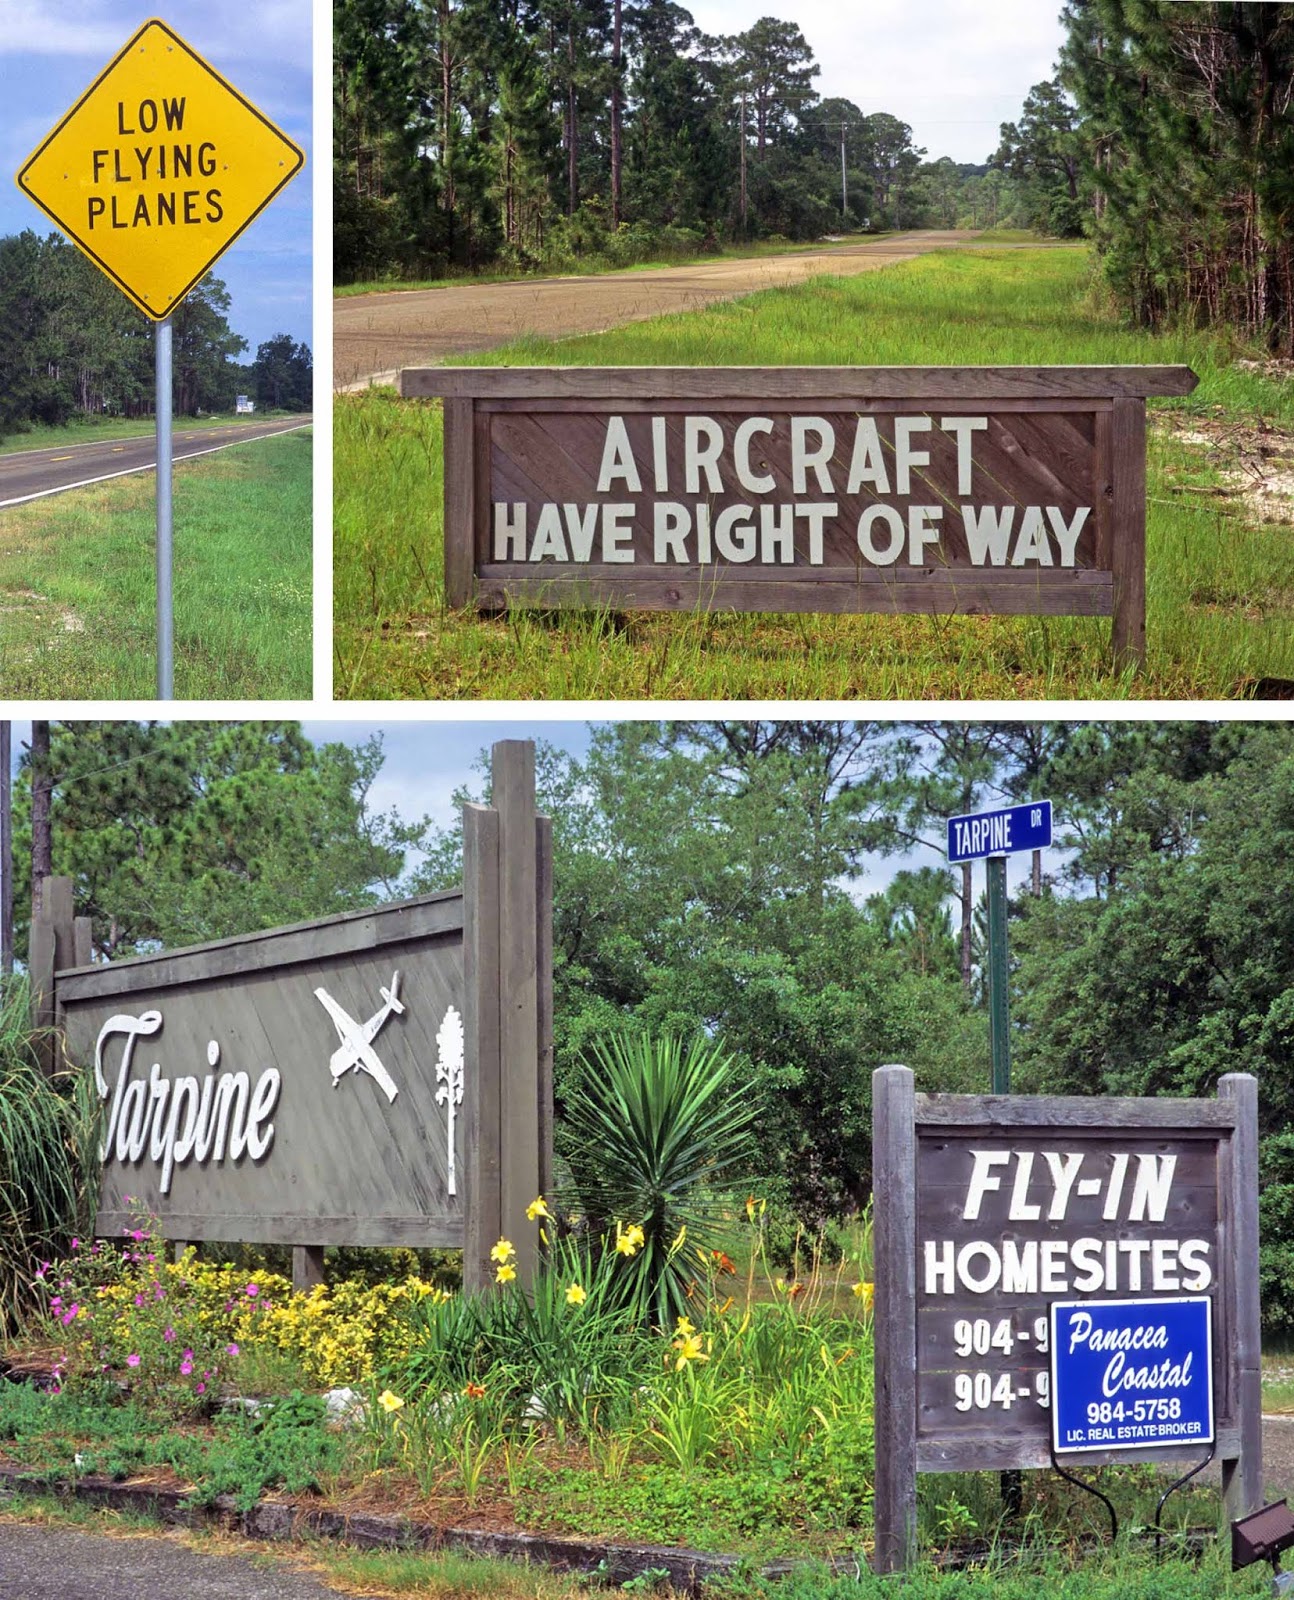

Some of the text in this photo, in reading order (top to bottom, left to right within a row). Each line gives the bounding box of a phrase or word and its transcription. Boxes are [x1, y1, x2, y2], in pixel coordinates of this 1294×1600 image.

[118, 97, 186, 135] LOW
[93, 142, 216, 183] FLYING
[88, 189, 223, 229] PLANES
[596, 416, 988, 495] AIRCRAFT
[494, 501, 1091, 567] HAVE RIGHT OF WAY
[955, 809, 1042, 856] TARPINE DR
[95, 1010, 280, 1193] Tarpine
[963, 1150, 1178, 1222] FLY-IN
[924, 1237, 1212, 1294] HOMESITES
[1069, 1312, 1168, 1354] Panacea
[1102, 1351, 1193, 1398] Coastal
[1087, 1397, 1181, 1424] 984-5758
[1067, 1430, 1086, 1442] LIC.
[1088, 1428, 1116, 1441] REAL
